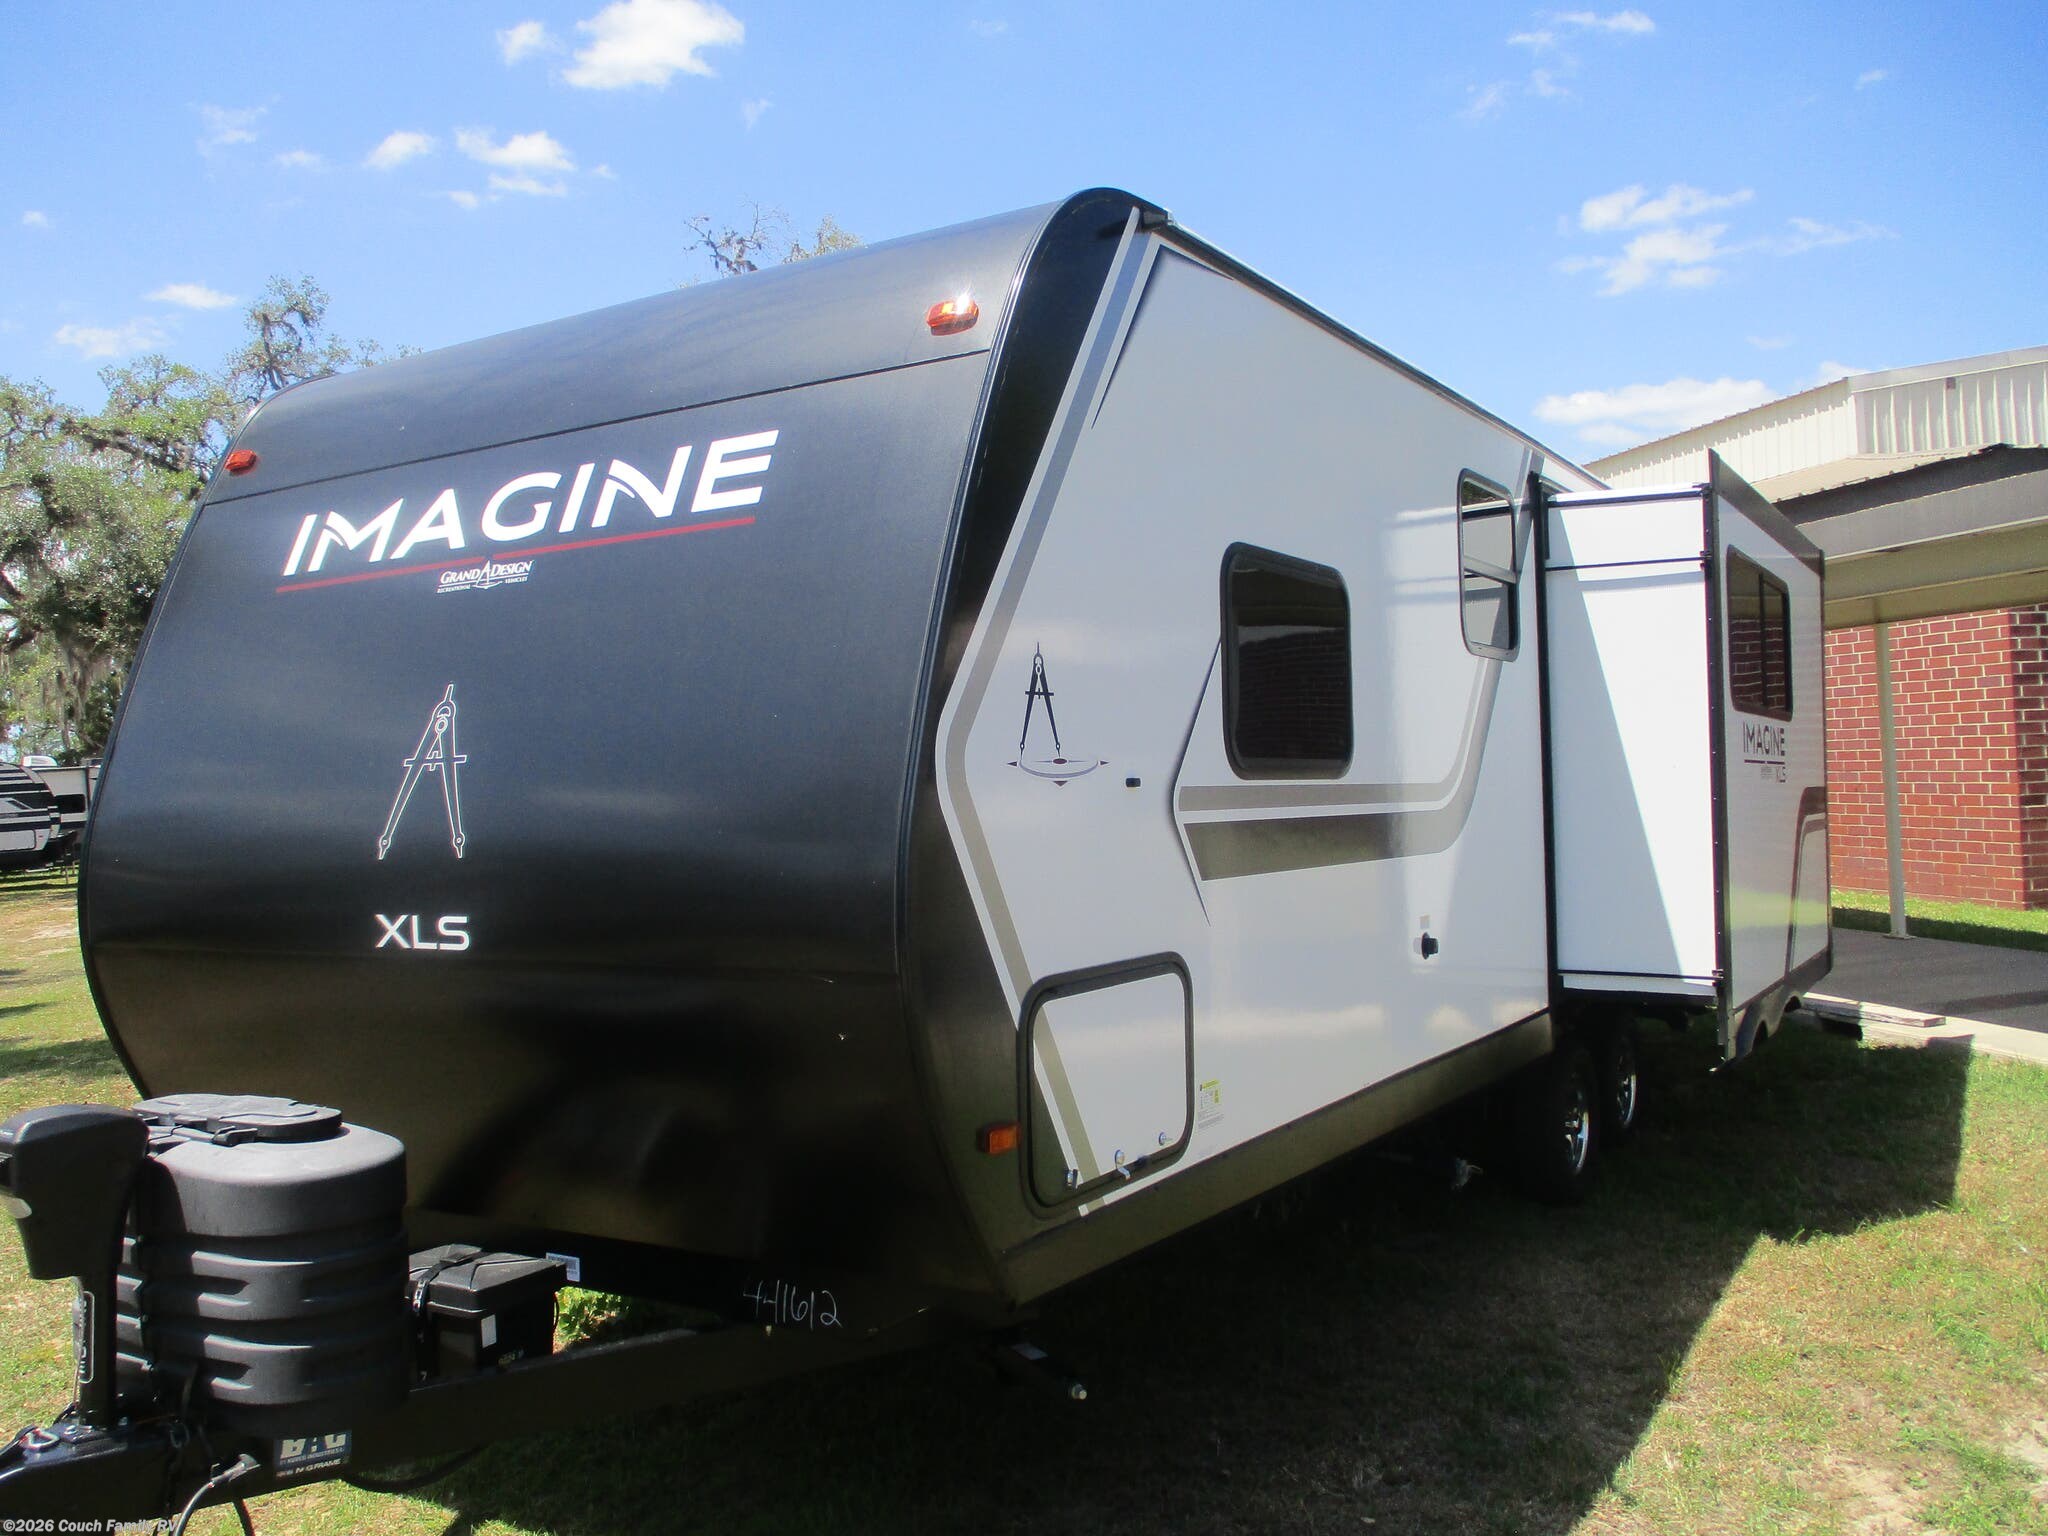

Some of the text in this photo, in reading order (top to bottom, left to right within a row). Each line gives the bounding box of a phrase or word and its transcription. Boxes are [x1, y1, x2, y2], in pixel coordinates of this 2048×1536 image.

[283, 429, 780, 577] IMAGINE
[440, 560, 534, 585] GRAND DESIGN
[1743, 721, 1785, 756] IMAGINE
[375, 913, 470, 951] XLS
